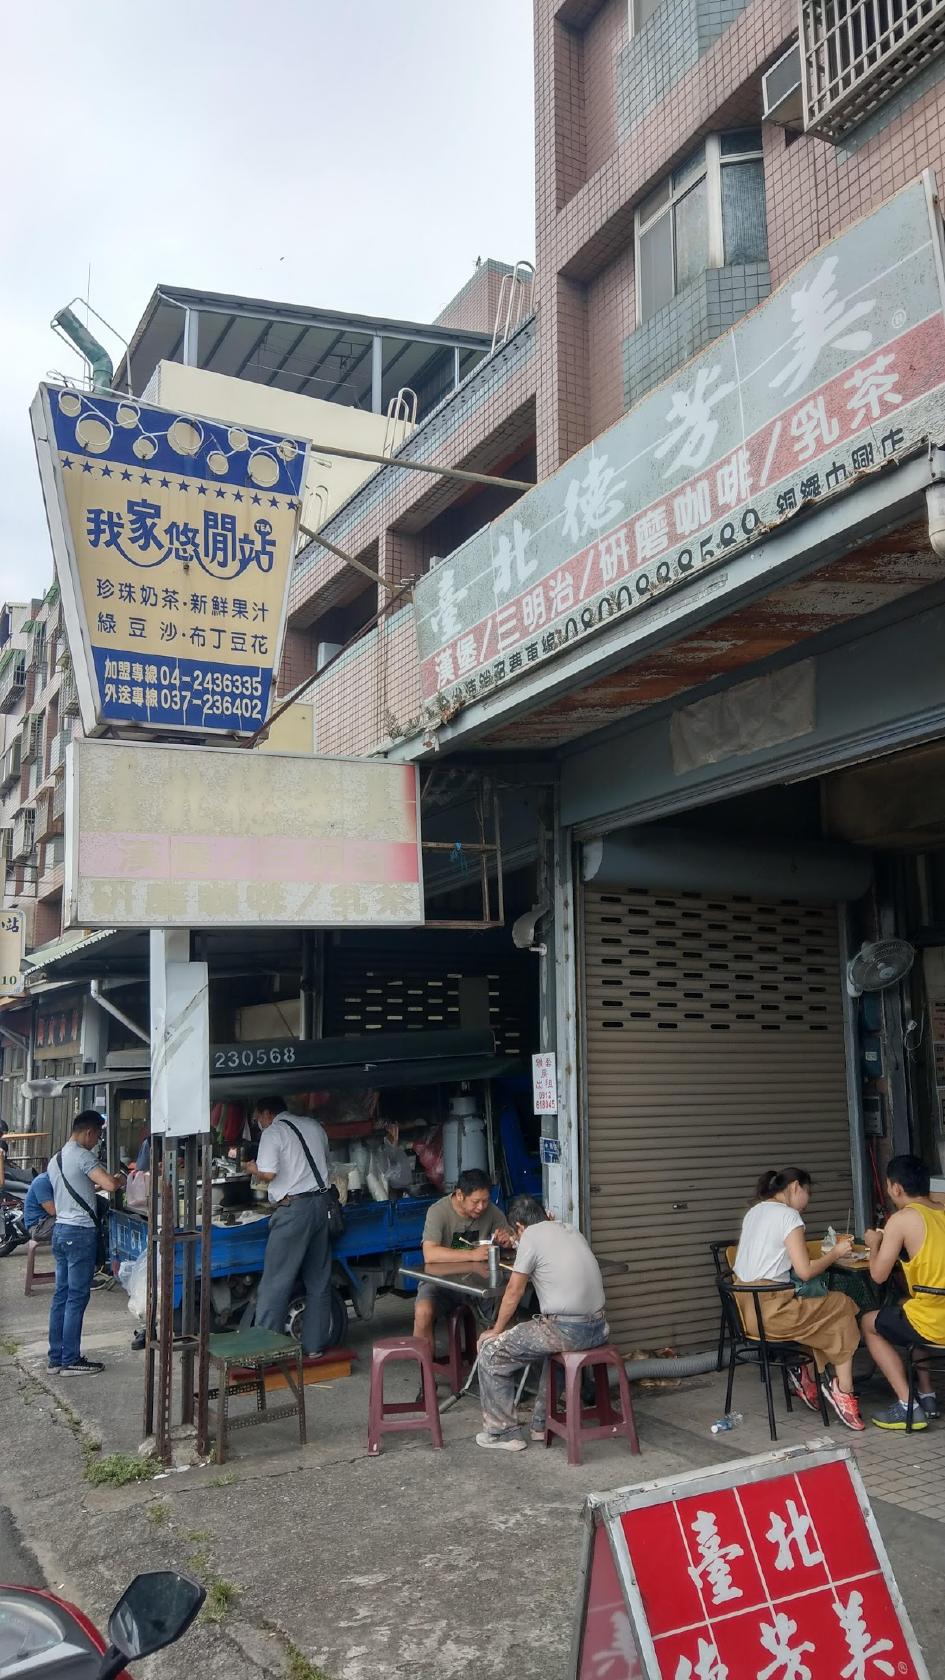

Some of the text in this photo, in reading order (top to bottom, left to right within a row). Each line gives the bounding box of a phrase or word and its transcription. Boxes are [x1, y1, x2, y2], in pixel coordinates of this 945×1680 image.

[86, 499, 276, 574] 我家悠閒站
[256, 523, 272, 532] TEA
[215, 1047, 296, 1068] 230568
[688, 1499, 823, 1605] 臺北
